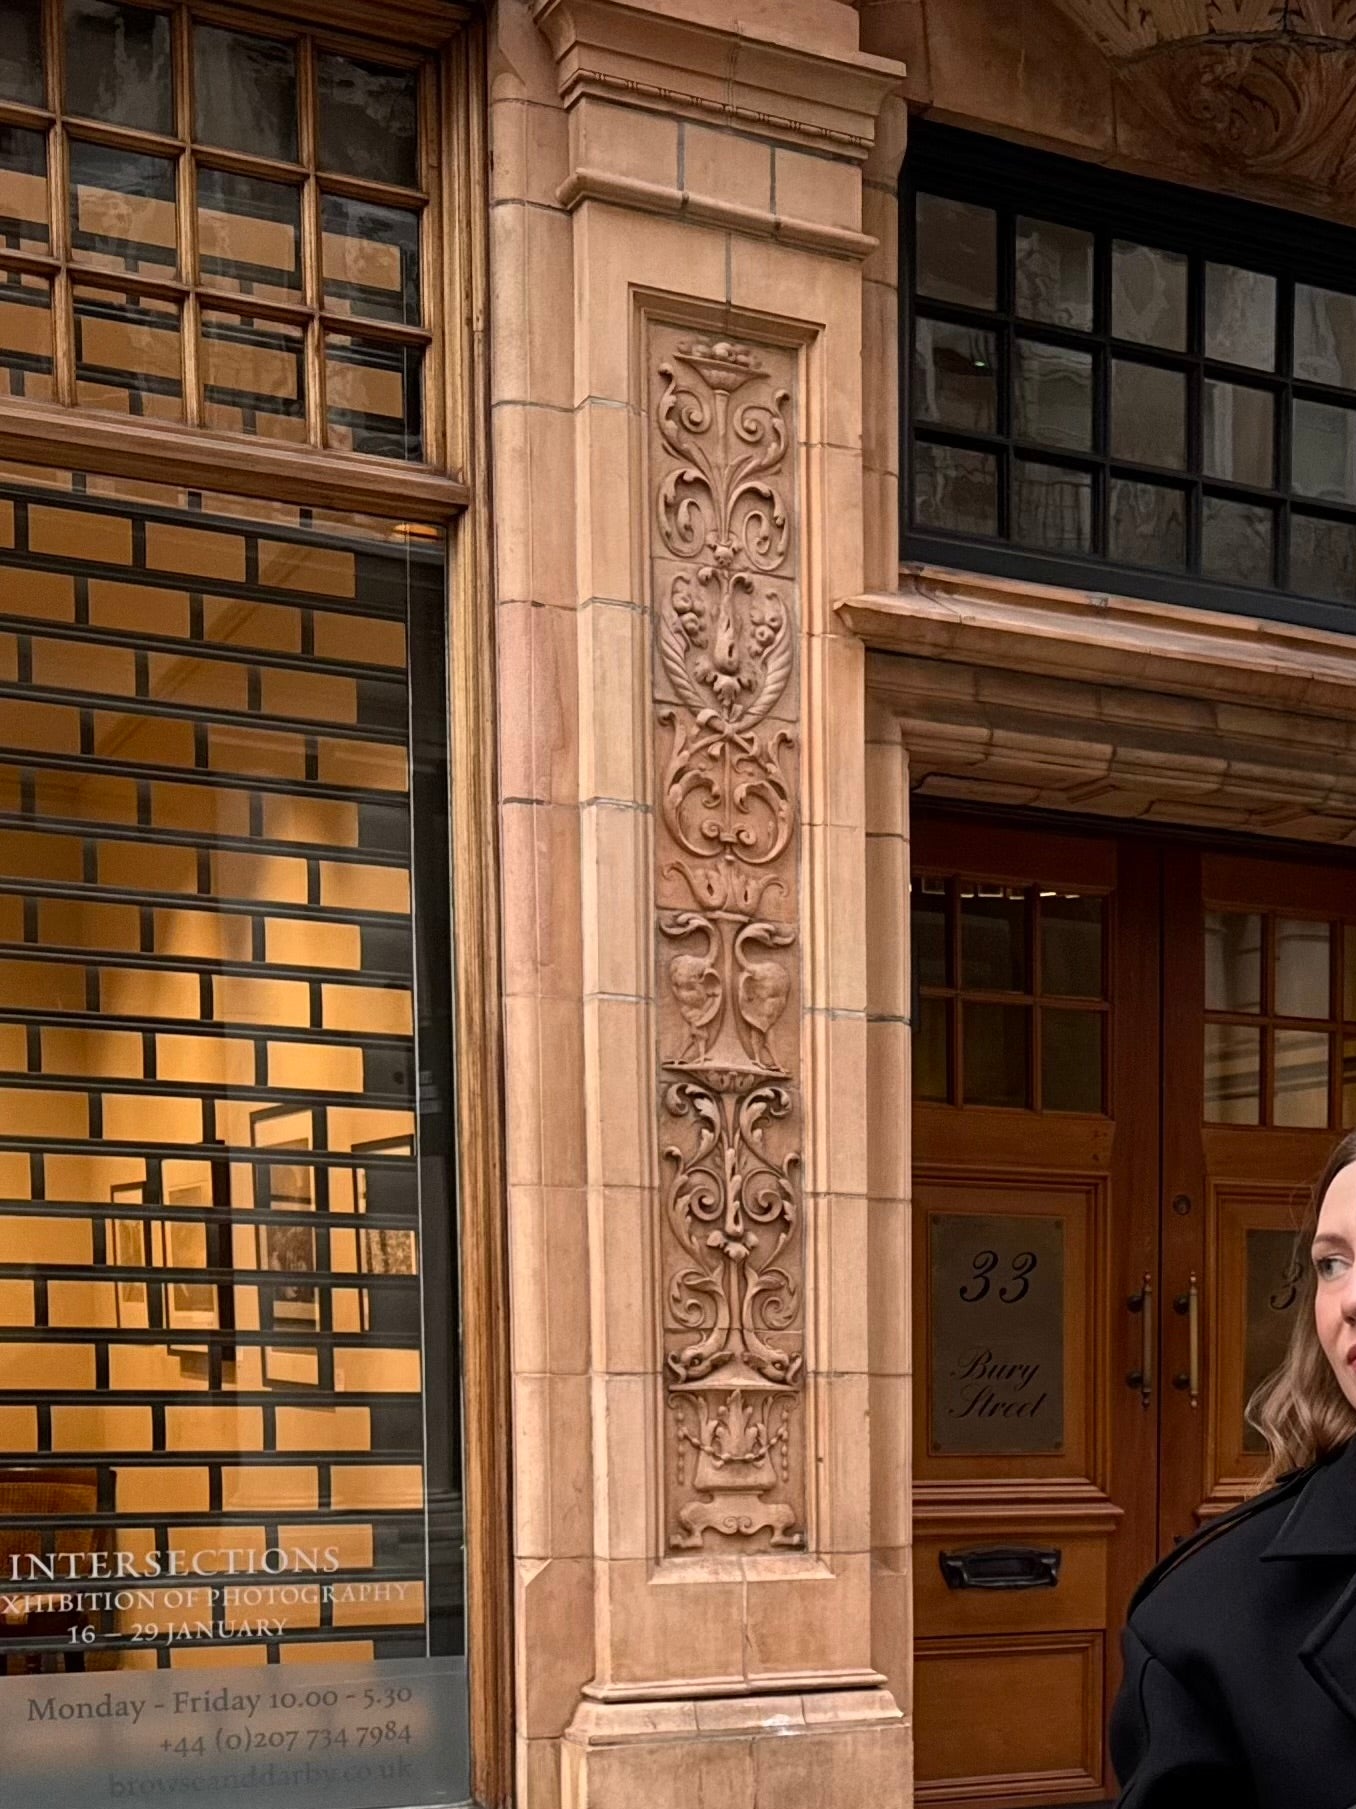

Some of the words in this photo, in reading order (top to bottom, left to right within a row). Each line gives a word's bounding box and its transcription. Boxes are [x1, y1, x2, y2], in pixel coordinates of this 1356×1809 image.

[959, 1250, 1038, 1304] 33
[950, 1348, 1041, 1391] Bury
[949, 1384, 1048, 1419] Street
[9, 1546, 340, 1582] INTERSECTIONS
[0, 1591, 155, 1615] XHIBITION
[164, 1589, 199, 1608] OF
[207, 1583, 409, 1607] PHOTOGRAPHY
[67, 1625, 95, 1645] 16
[131, 1622, 158, 1642] 29
[167, 1617, 288, 1646] JANUARY
[27, 1693, 146, 1725] Monday
[173, 1688, 260, 1718] Friday
[269, 1690, 339, 1709] 10.00
[363, 1687, 413, 1710] 5.30
[160, 1735, 206, 1758] +44
[215, 1727, 299, 1752] (0)207
[306, 1728, 350, 1750] 734
[356, 1720, 412, 1748] 7984
